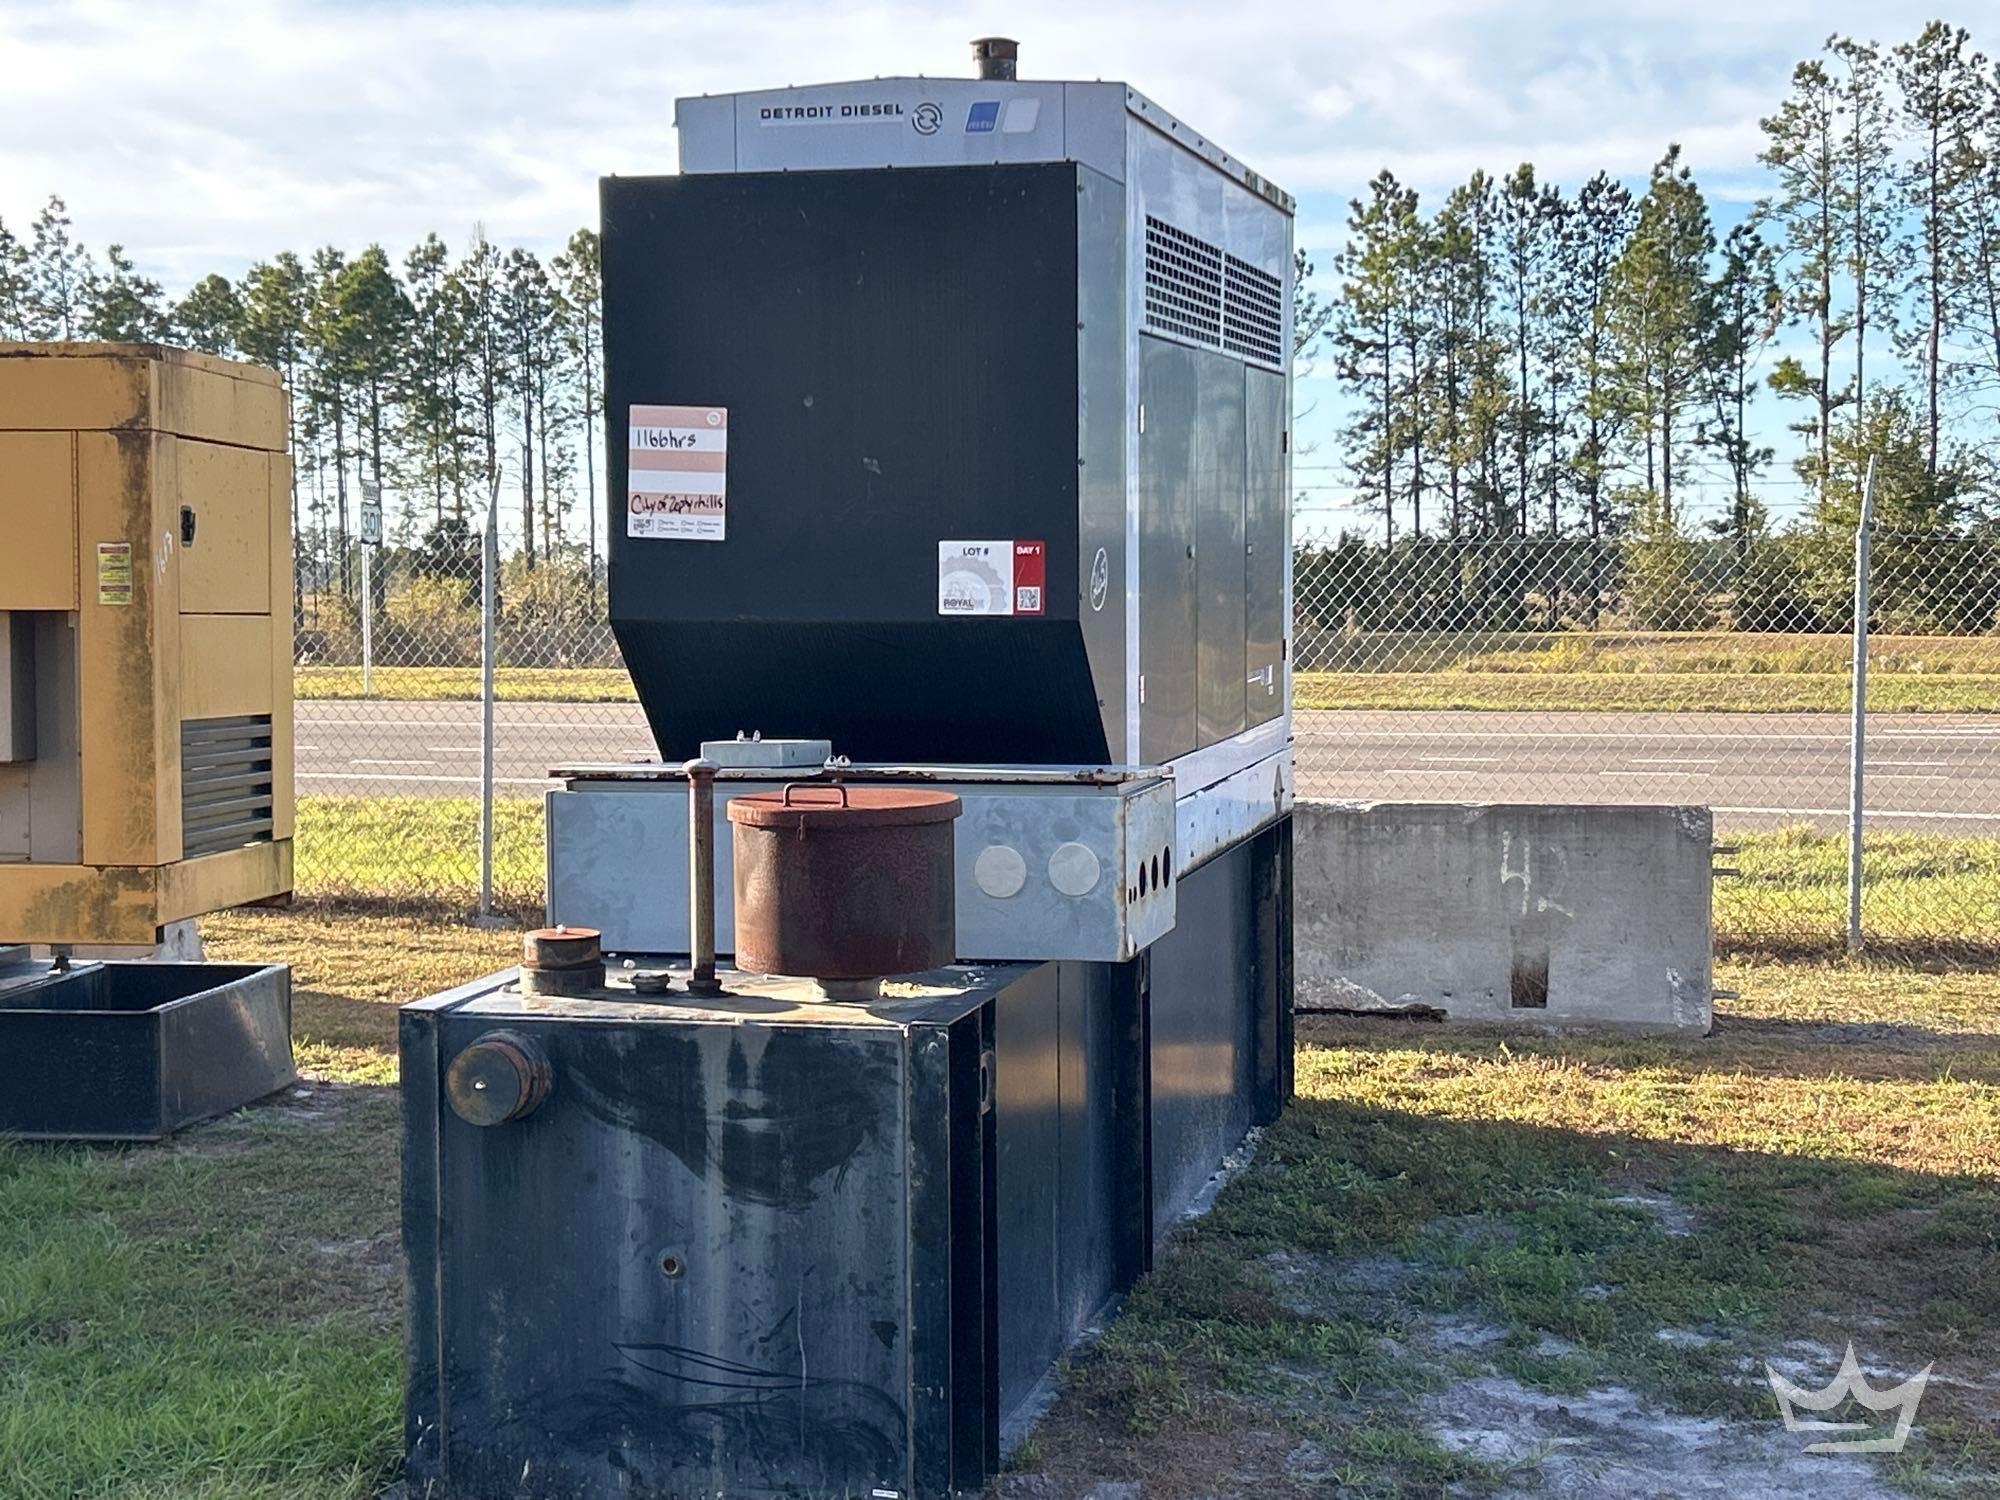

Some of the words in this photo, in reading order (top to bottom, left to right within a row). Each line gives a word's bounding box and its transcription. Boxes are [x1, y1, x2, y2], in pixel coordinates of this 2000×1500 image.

[761, 106, 833, 119] DETROIT
[841, 102, 903, 116] DIESEL
[963, 548, 981, 556] LOT
[1016, 546, 1033, 555] DAY
[1034, 546, 1040, 555] 1
[944, 598, 974, 607] ROYAL
